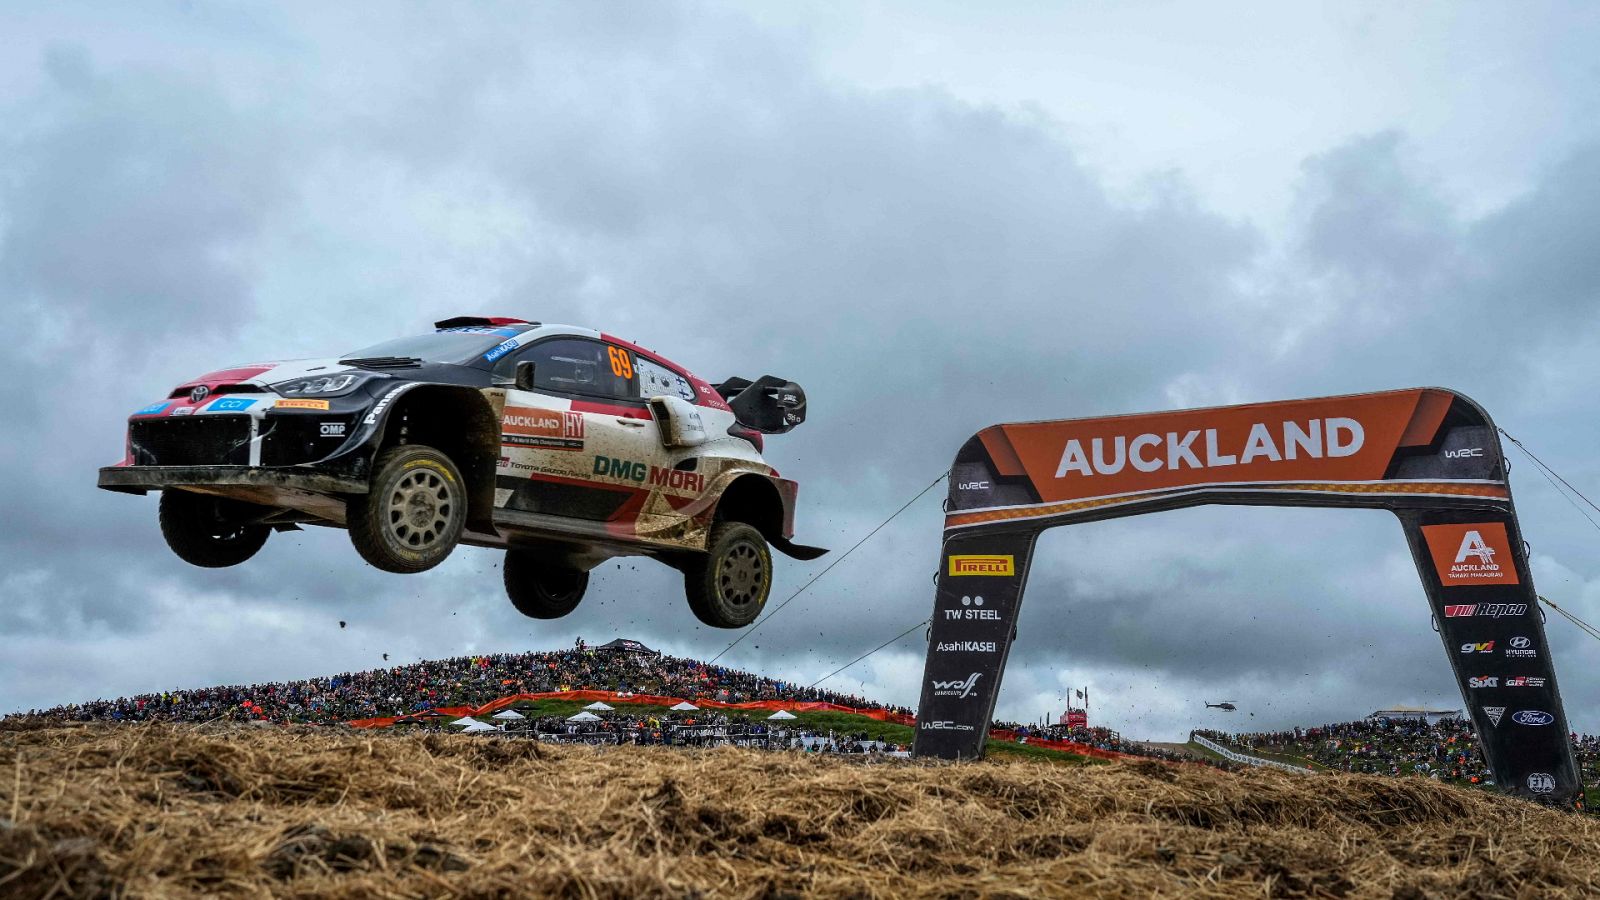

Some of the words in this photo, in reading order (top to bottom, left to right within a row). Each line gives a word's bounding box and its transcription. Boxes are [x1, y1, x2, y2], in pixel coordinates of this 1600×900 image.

[607, 345, 633, 379] 69
[503, 414, 559, 429] AUCKLAND
[565, 413, 582, 437] HY
[320, 425, 346, 433] OMP
[1054, 417, 1365, 478] AUCKLAND
[1445, 449, 1483, 458] WRC
[593, 455, 647, 482] DMG
[649, 466, 705, 492] MORI
[959, 481, 989, 490] WRC
[955, 559, 1008, 572] PIRELLI
[945, 609, 962, 620] TW
[965, 609, 1001, 620] STEEL
[936, 641, 996, 652] AsahiKASEI
[1520, 712, 1547, 724] Ford
